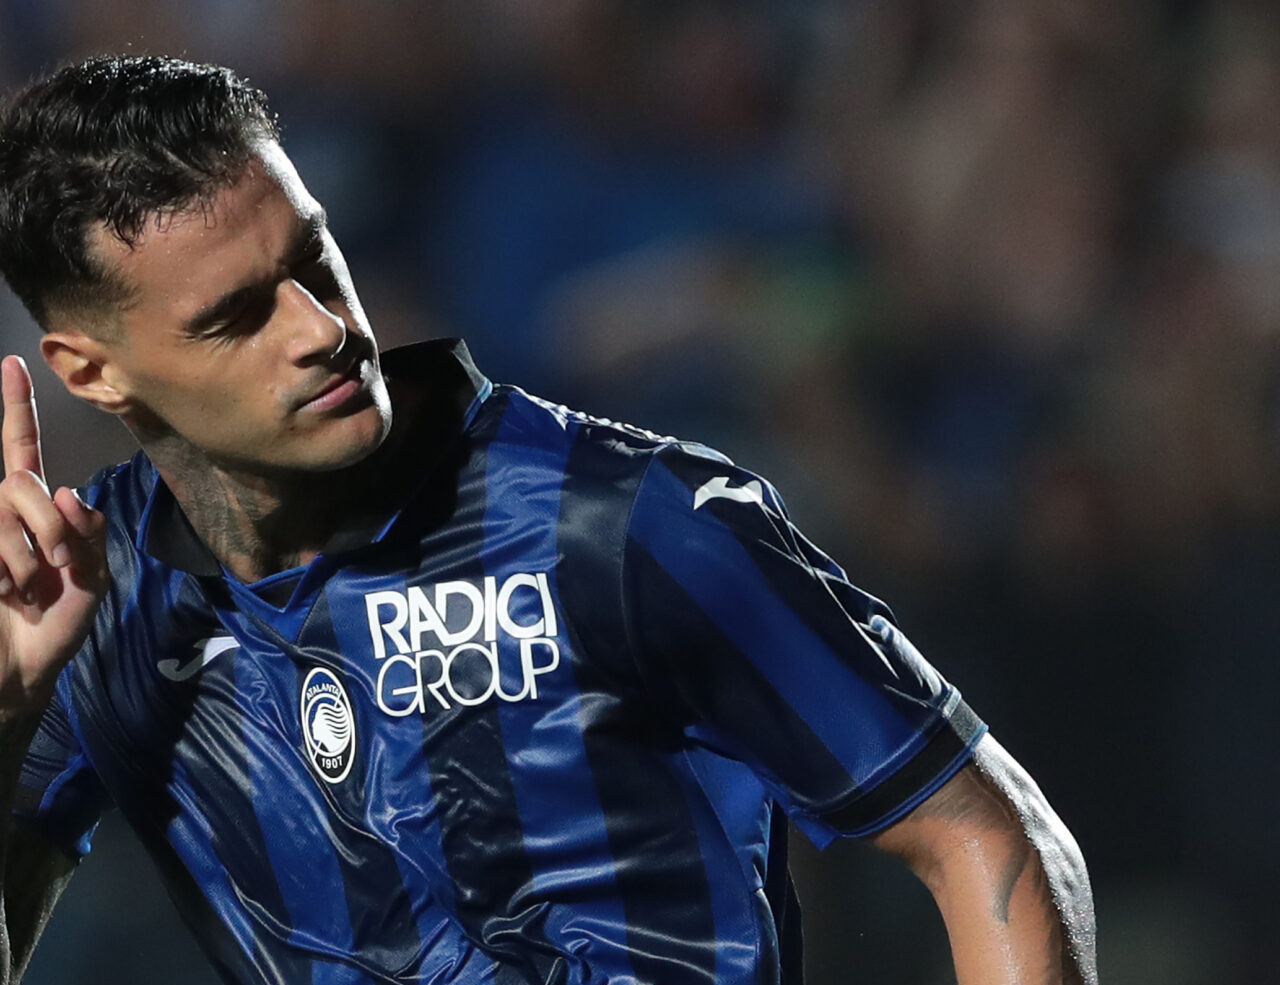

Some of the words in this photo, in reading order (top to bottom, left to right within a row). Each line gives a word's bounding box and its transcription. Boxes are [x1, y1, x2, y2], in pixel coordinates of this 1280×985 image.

[365, 573, 558, 659] RADICI
[306, 683, 341, 700] ATALANTA
[376, 637, 560, 717] GROUP
[322, 756, 343, 769] 1907
